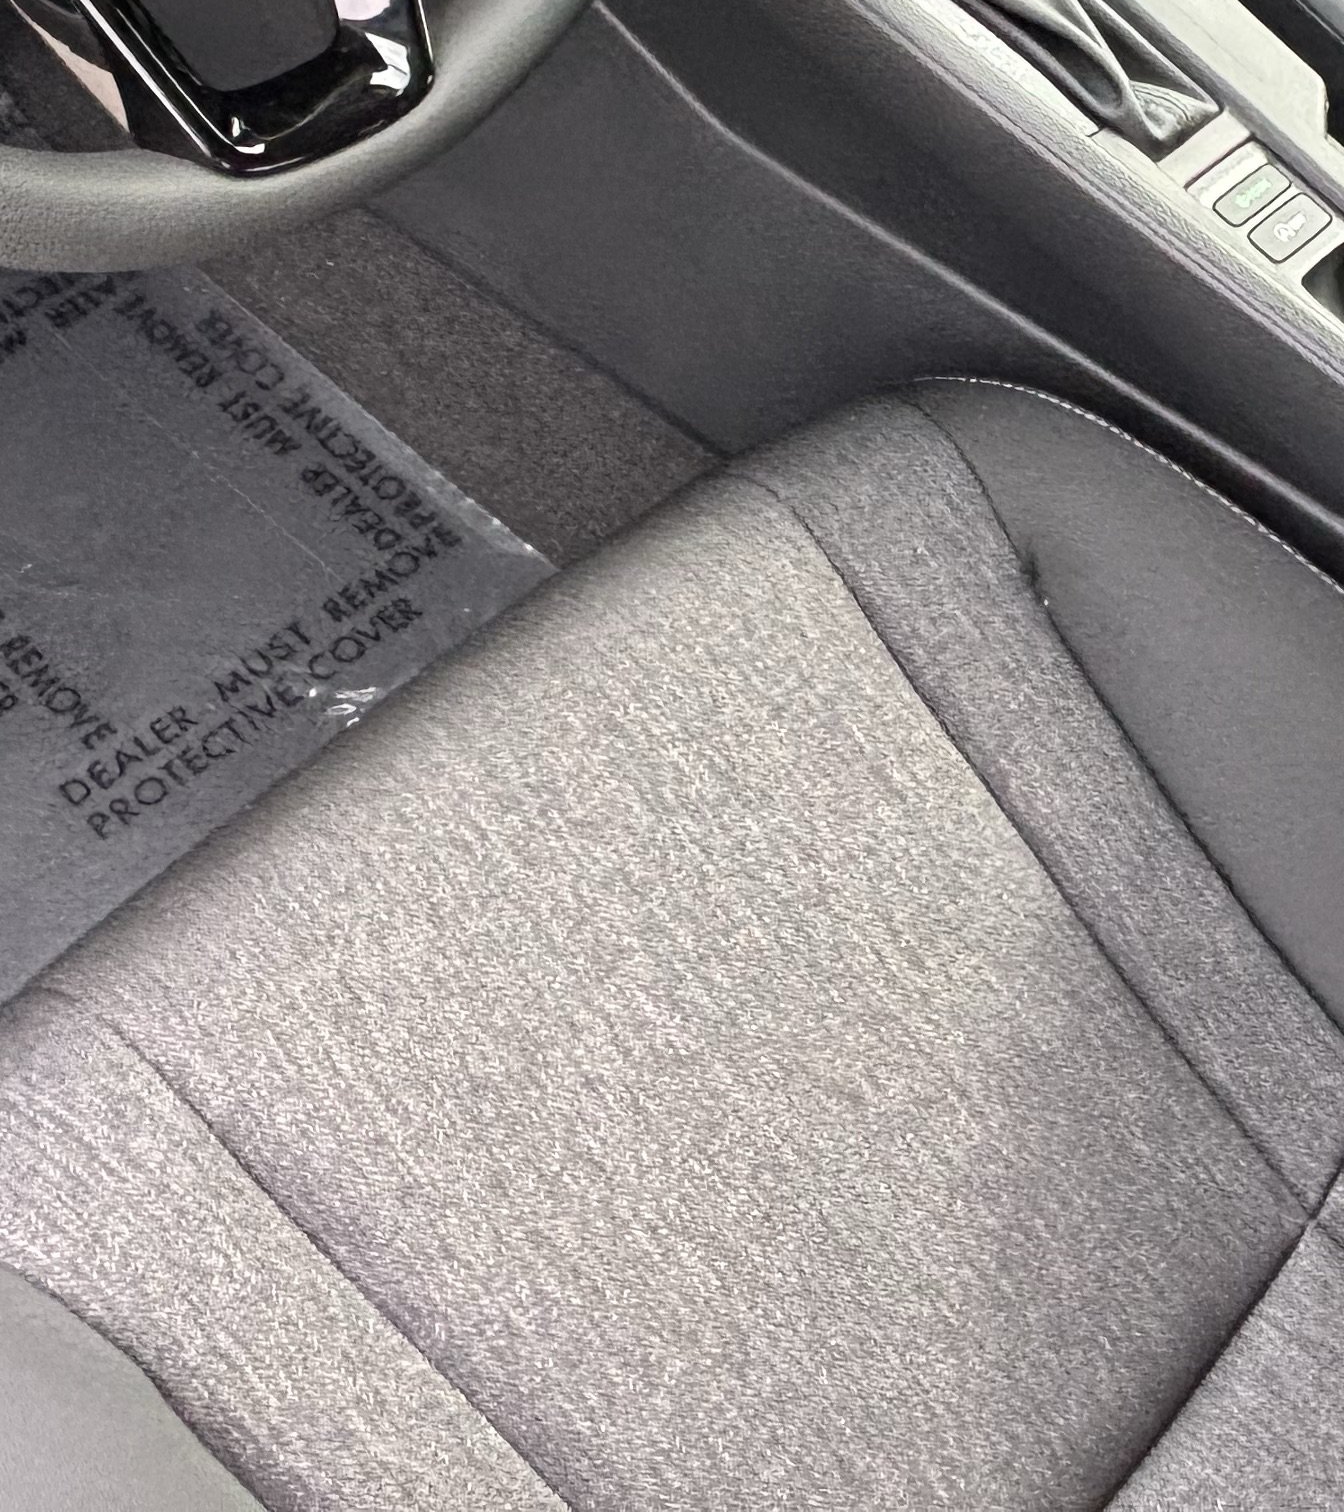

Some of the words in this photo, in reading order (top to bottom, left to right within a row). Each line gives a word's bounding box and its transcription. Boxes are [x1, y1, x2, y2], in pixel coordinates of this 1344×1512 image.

[193, 307, 285, 391] COVER
[215, 388, 303, 457] MUST
[277, 389, 438, 532] PROTECTIVE
[299, 460, 404, 552] DEALER
[57, 704, 200, 807] DEALER
[212, 619, 313, 704] MUST
[322, 526, 464, 624] REMOVE
[85, 679, 306, 842] PROTECTIVE
[307, 596, 424, 681] COVER
